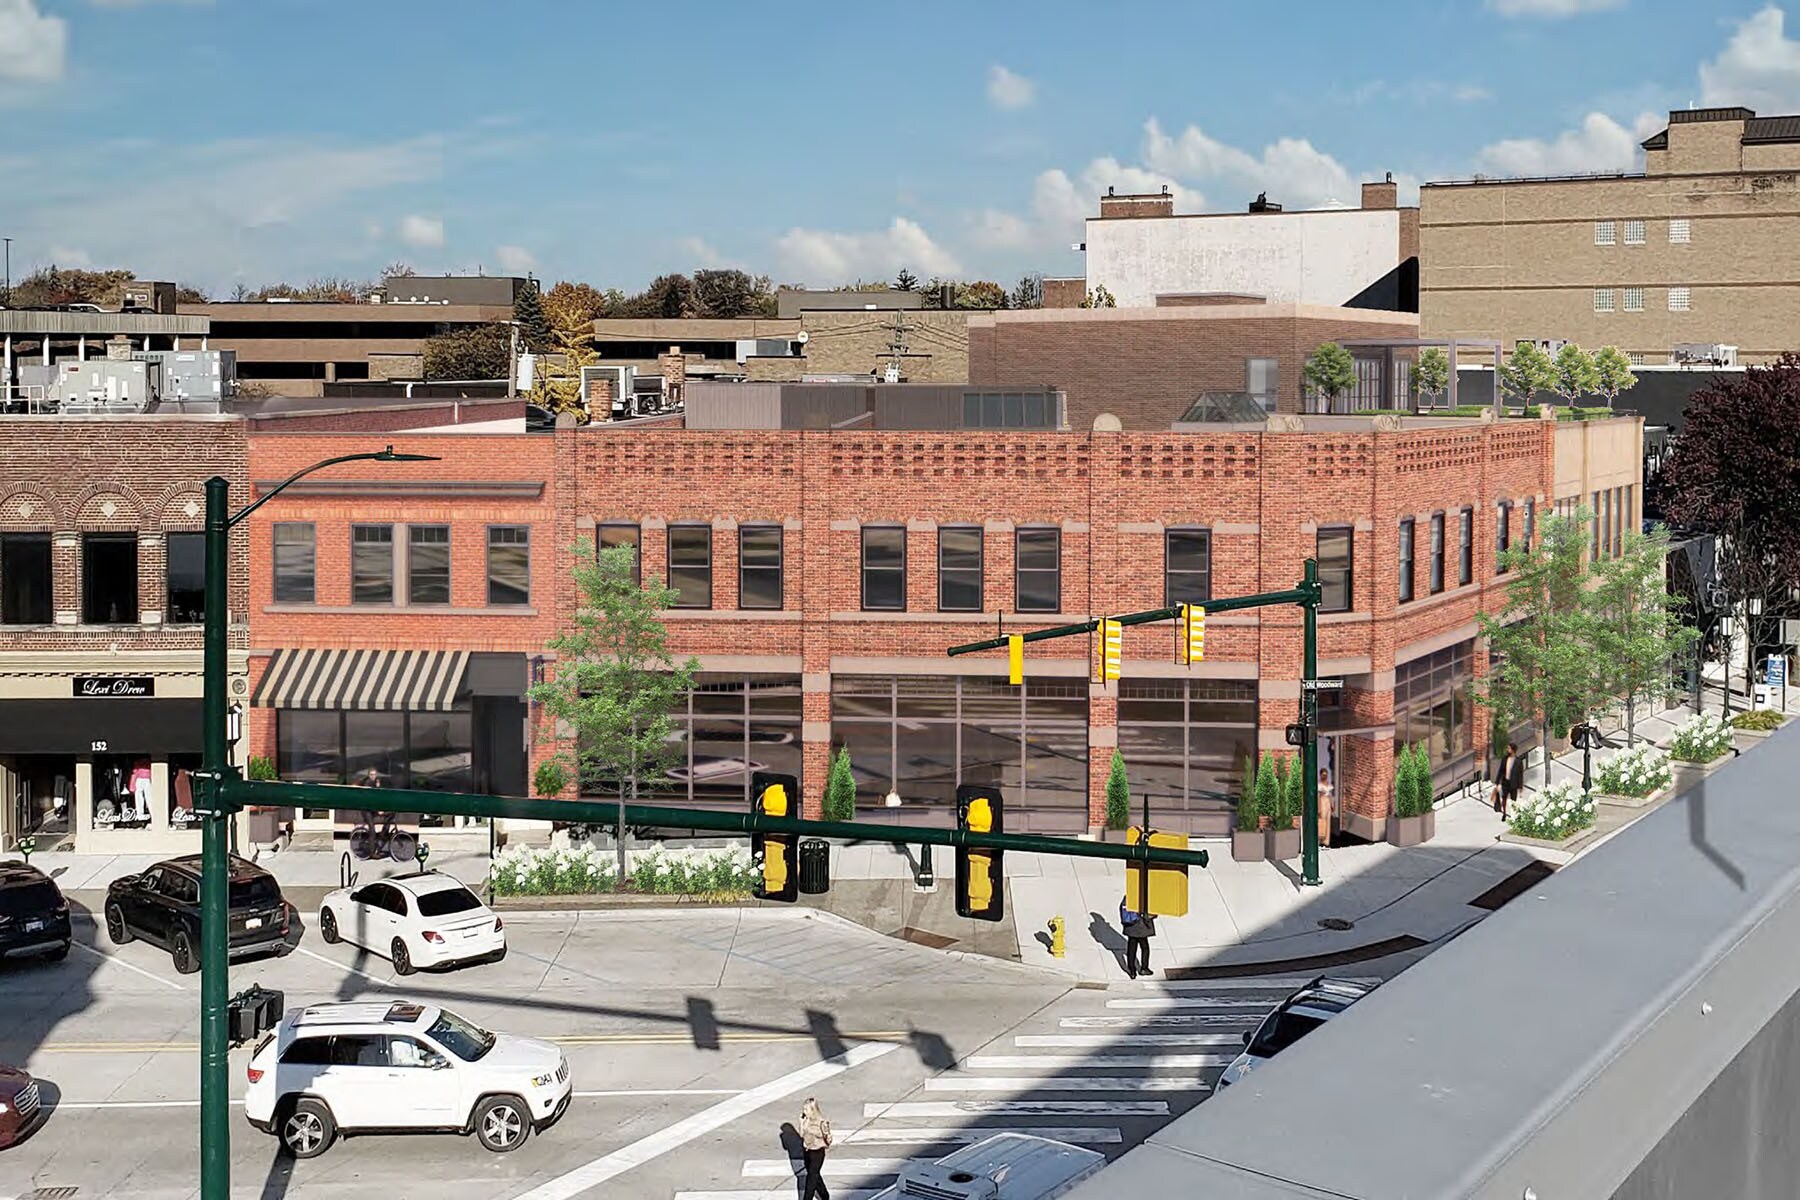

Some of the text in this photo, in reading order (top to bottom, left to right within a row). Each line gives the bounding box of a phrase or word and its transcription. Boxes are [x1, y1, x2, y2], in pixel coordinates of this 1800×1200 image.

[82, 679, 145, 695] Lexi Drew
[1316, 681, 1343, 689] Woodward
[91, 741, 107, 751] 152
